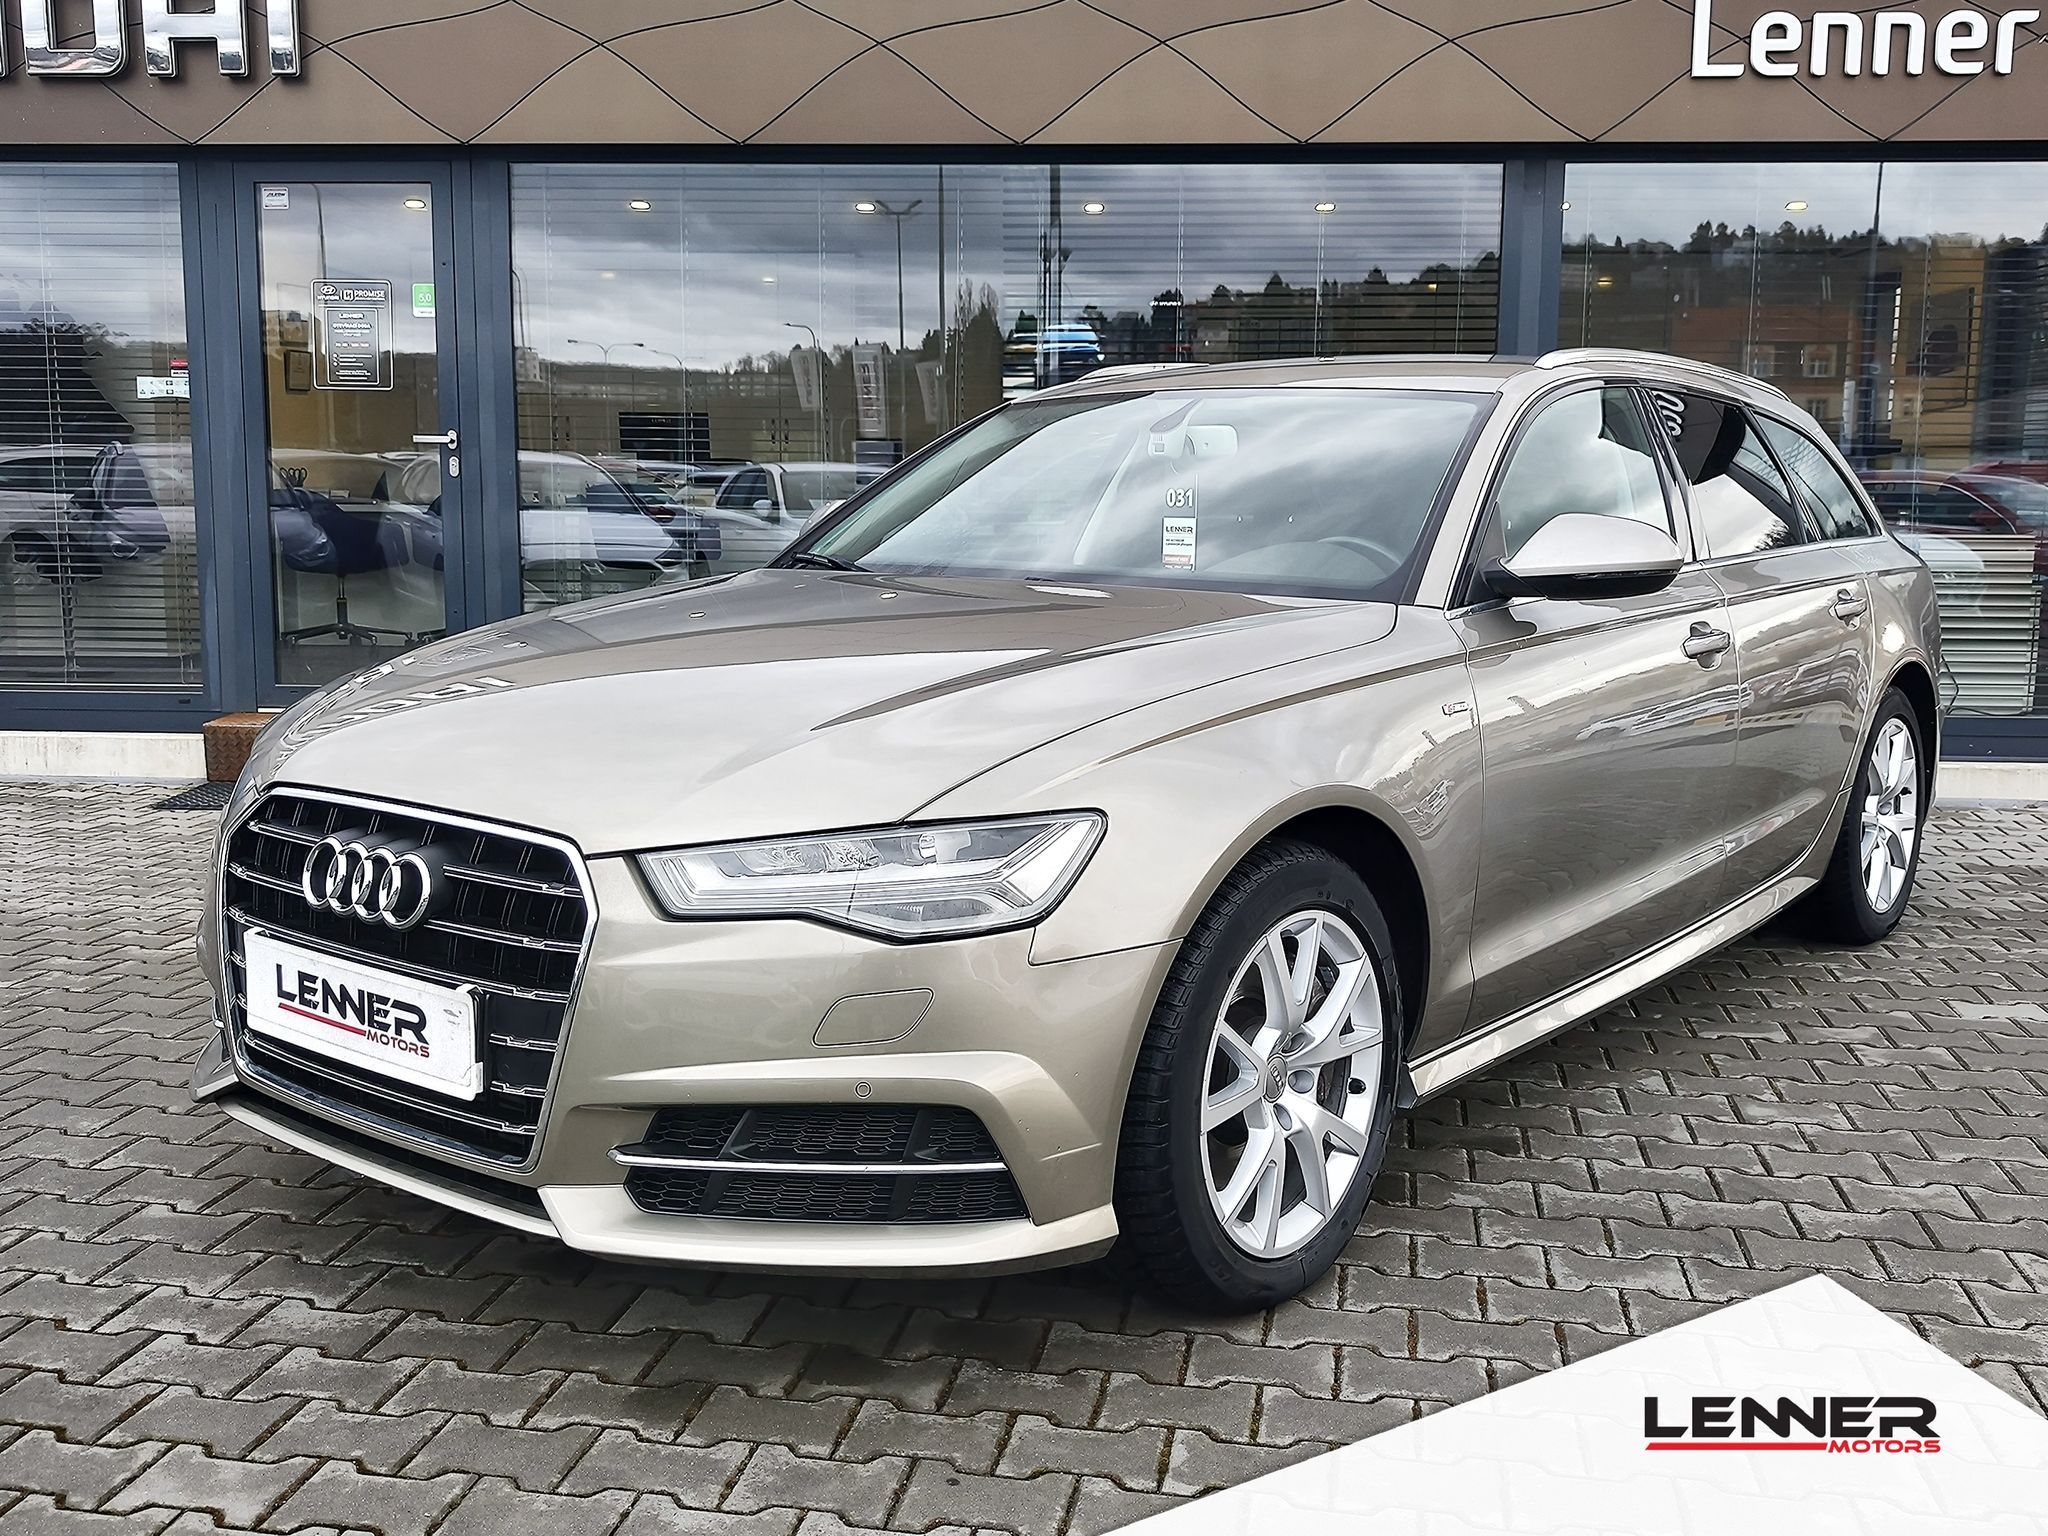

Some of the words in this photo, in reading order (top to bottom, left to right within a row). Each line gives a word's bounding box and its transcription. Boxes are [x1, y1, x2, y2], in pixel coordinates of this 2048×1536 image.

[0, 0, 299, 76] DAI
[1691, 0, 2041, 78] Lenner
[354, 289, 385, 298] PROMISE
[1166, 488, 1193, 508] 031
[1165, 525, 1193, 534] LENNER
[276, 963, 430, 1045] LENNER
[366, 1028, 430, 1058] MOTORS
